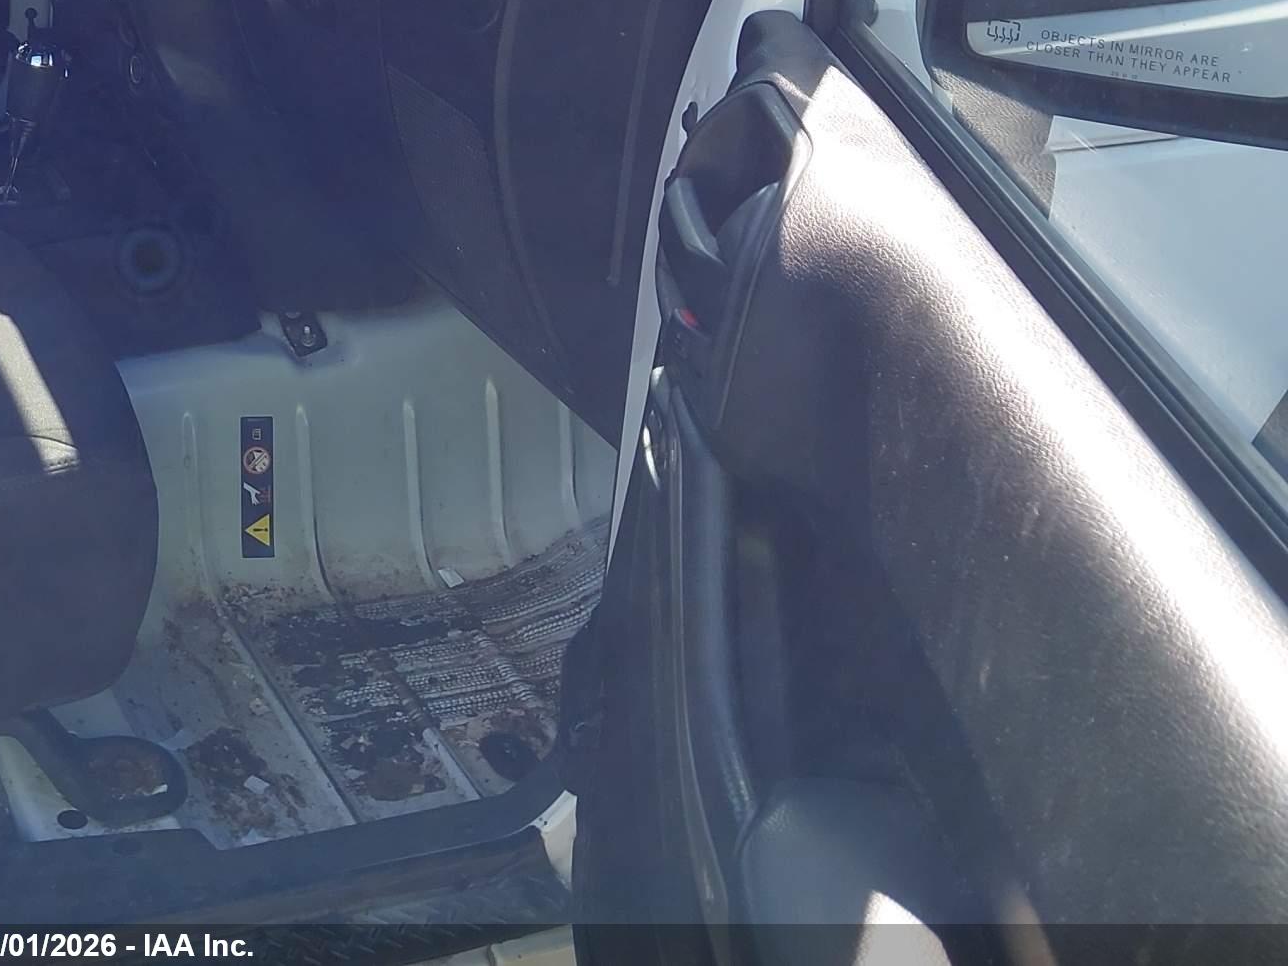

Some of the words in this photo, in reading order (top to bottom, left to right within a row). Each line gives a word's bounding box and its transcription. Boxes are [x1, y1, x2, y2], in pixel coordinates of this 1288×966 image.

[1025, 41, 1081, 57] CLOSER
[1088, 51, 1124, 67] THAN
[1131, 57, 1166, 74] THEY
[1172, 66, 1232, 83] APPEAR
[1041, 29, 1105, 49] OBJECTS
[1110, 40, 1125, 53] IN
[1128, 43, 1185, 62] MIRROR
[1189, 53, 1220, 68] ARE
